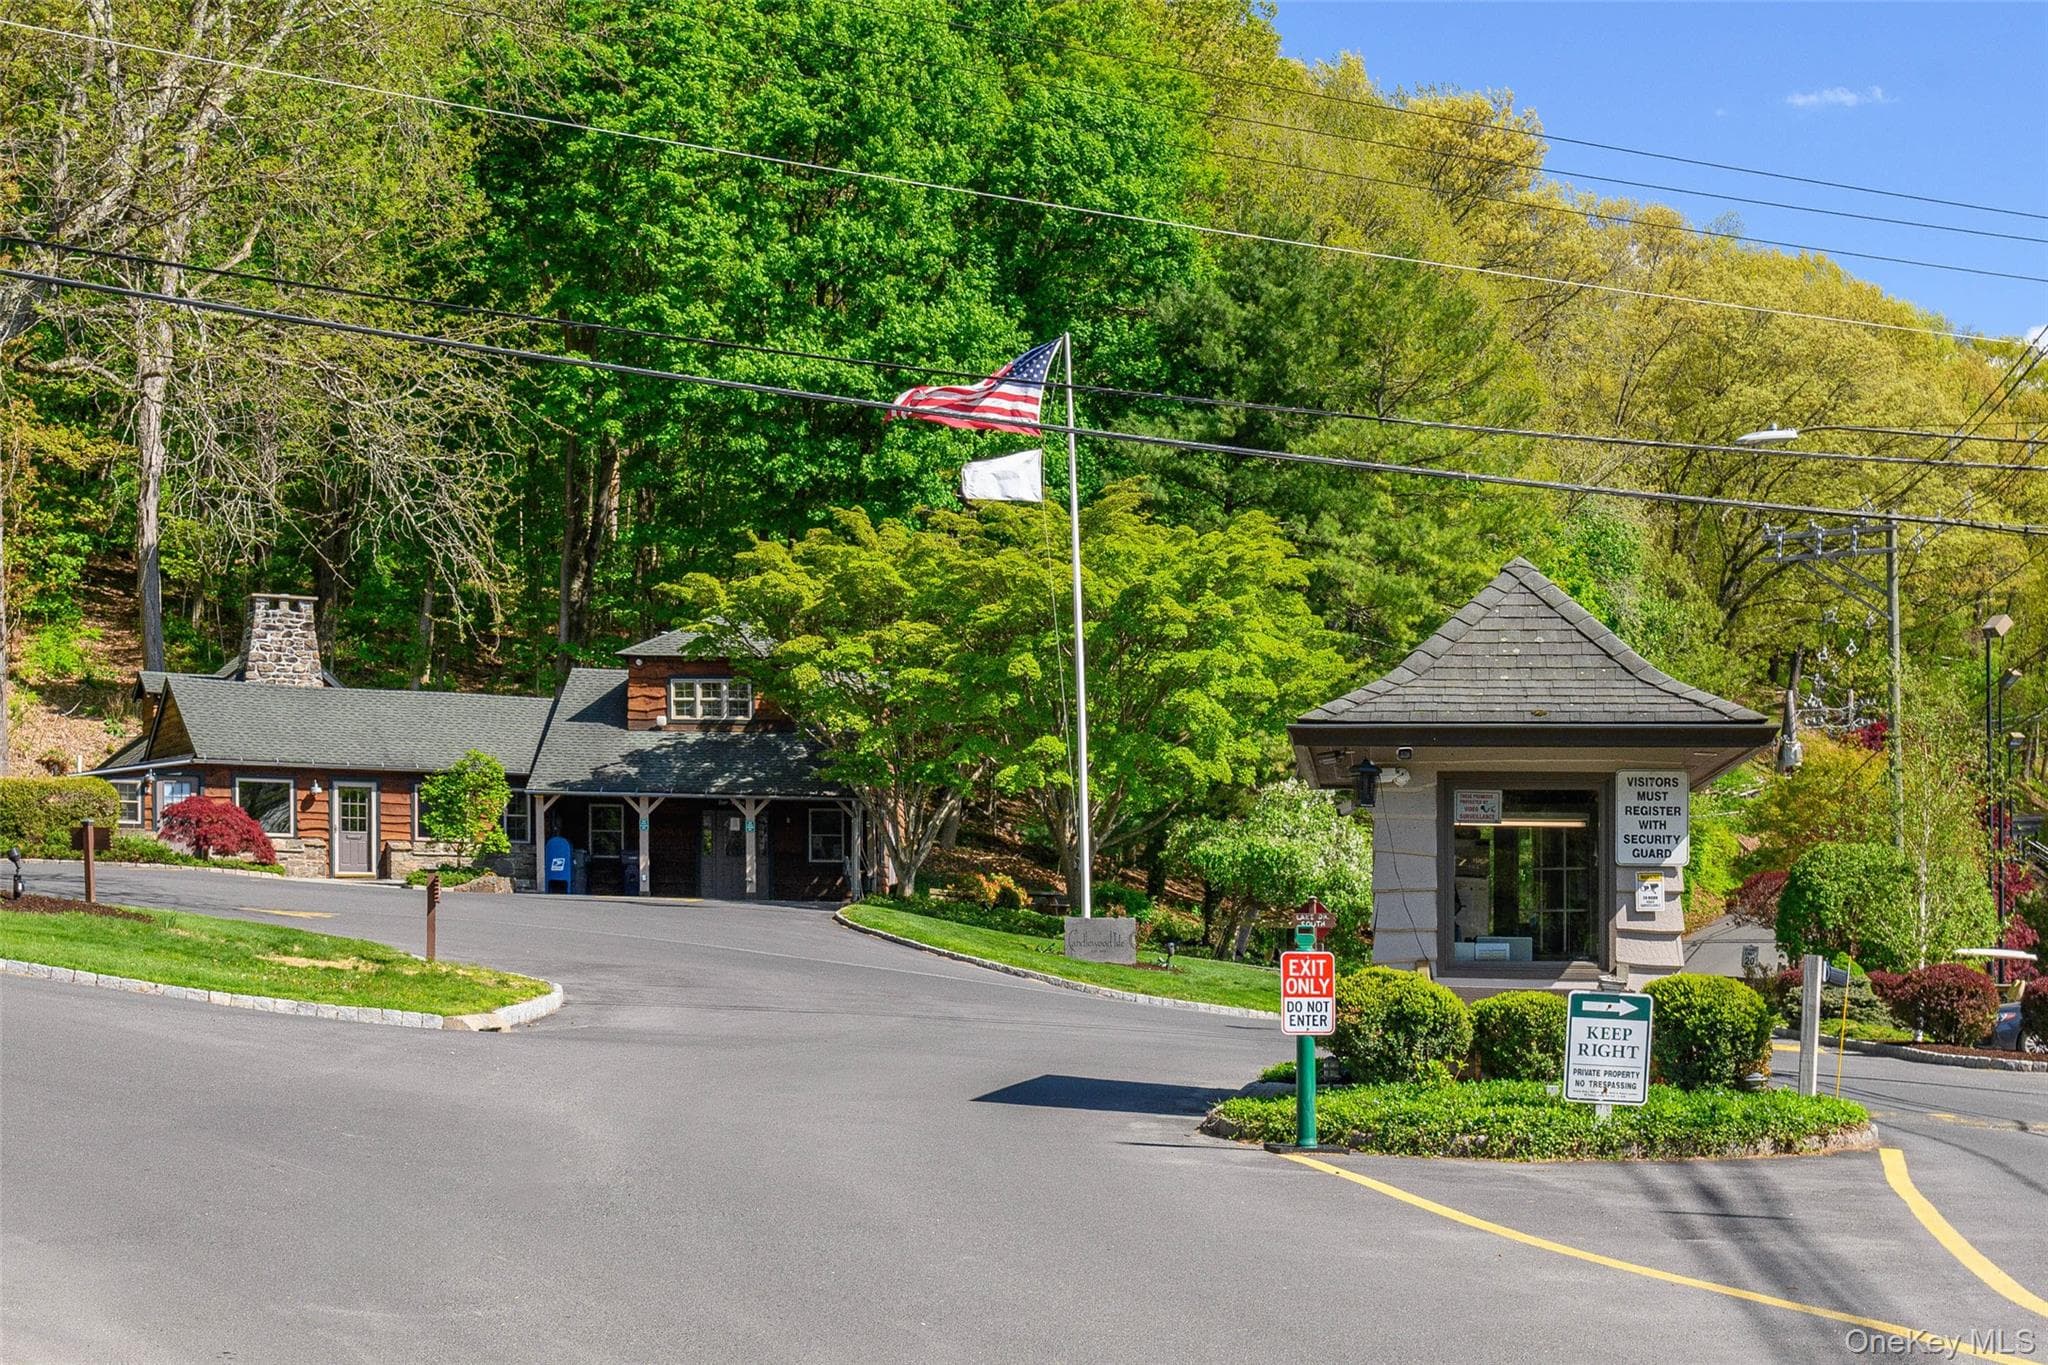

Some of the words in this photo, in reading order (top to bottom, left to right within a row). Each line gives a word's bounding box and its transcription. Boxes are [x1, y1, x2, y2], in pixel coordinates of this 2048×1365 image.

[1626, 777, 1679, 787] VISITORS
[1637, 791, 1668, 802] MUST
[1625, 806, 1681, 816] REGISTER
[1638, 820, 1667, 830] WITH
[1623, 834, 1681, 844] SECURITY
[1632, 848, 1672, 859] GUARD
[1744, 957, 1755, 965] 20
[1289, 959, 1327, 977] EXIT
[1286, 978, 1330, 995] ONLY
[1287, 1001, 1303, 1013] DO
[1307, 1001, 1330, 1013] NOT
[1289, 1014, 1328, 1027] ENTER
[1587, 1026, 1633, 1041] KEEP
[1578, 1043, 1640, 1059] RIGHT
[1572, 1068, 1601, 1077] PRIVATE
[1603, 1069, 1641, 1079] PROPERTY
[1589, 1080, 1637, 1090] TRESPASSING
